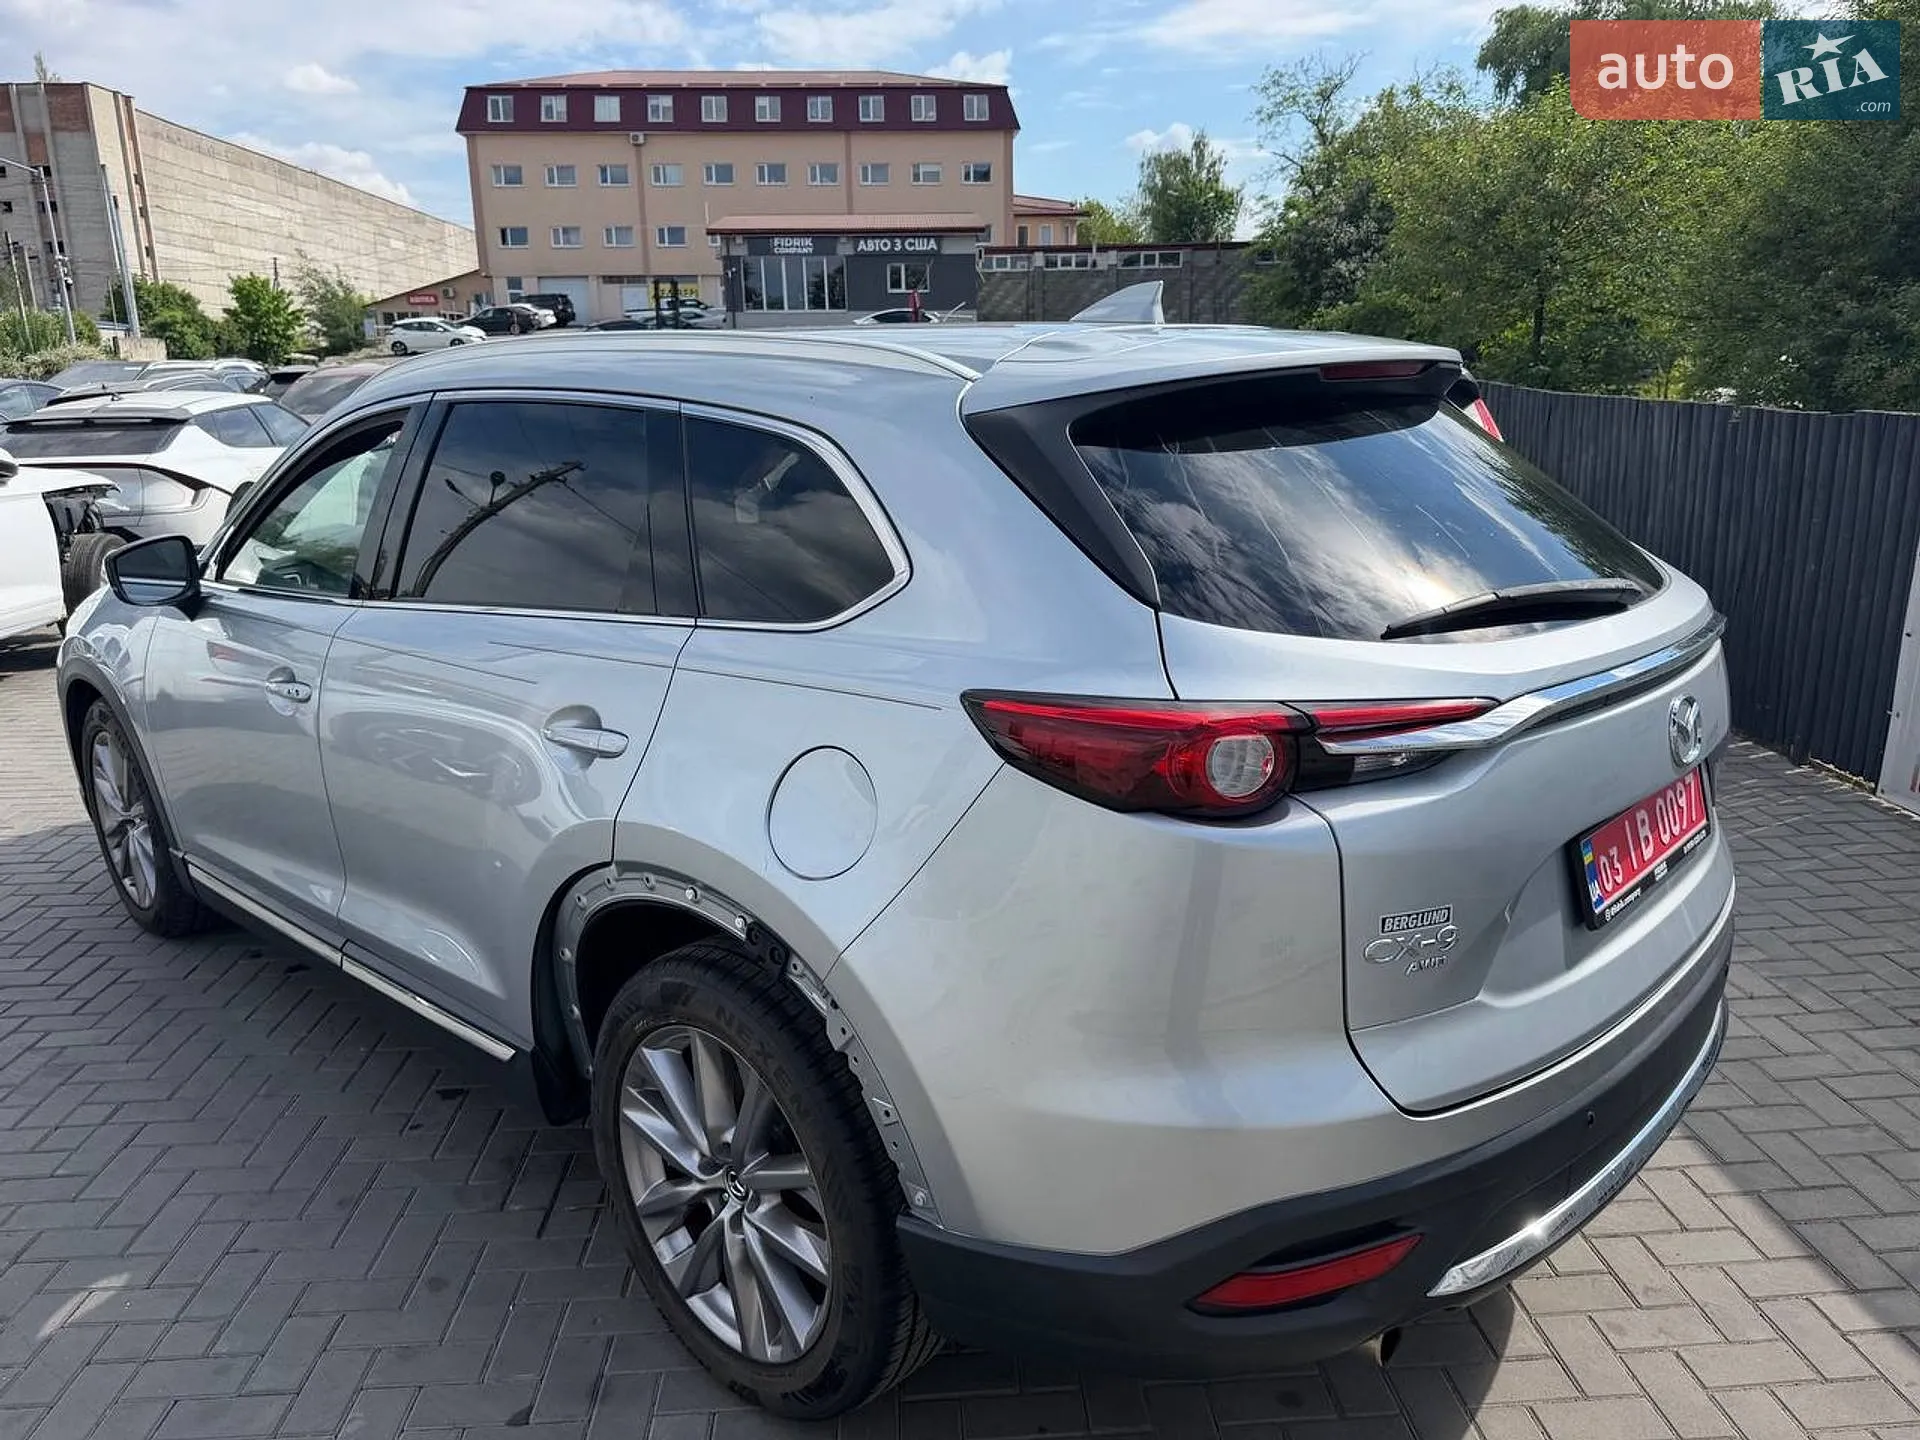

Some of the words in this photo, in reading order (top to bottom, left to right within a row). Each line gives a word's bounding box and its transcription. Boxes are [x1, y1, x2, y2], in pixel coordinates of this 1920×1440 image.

[774, 237, 813, 247] FIDRIK
[857, 238, 891, 252] АВТО
[904, 237, 937, 251] США
[1599, 846, 1623, 892] 03
[1656, 772, 1697, 846] 0097
[1383, 908, 1449, 932] BERGLUND
[1364, 925, 1459, 963] CX-9
